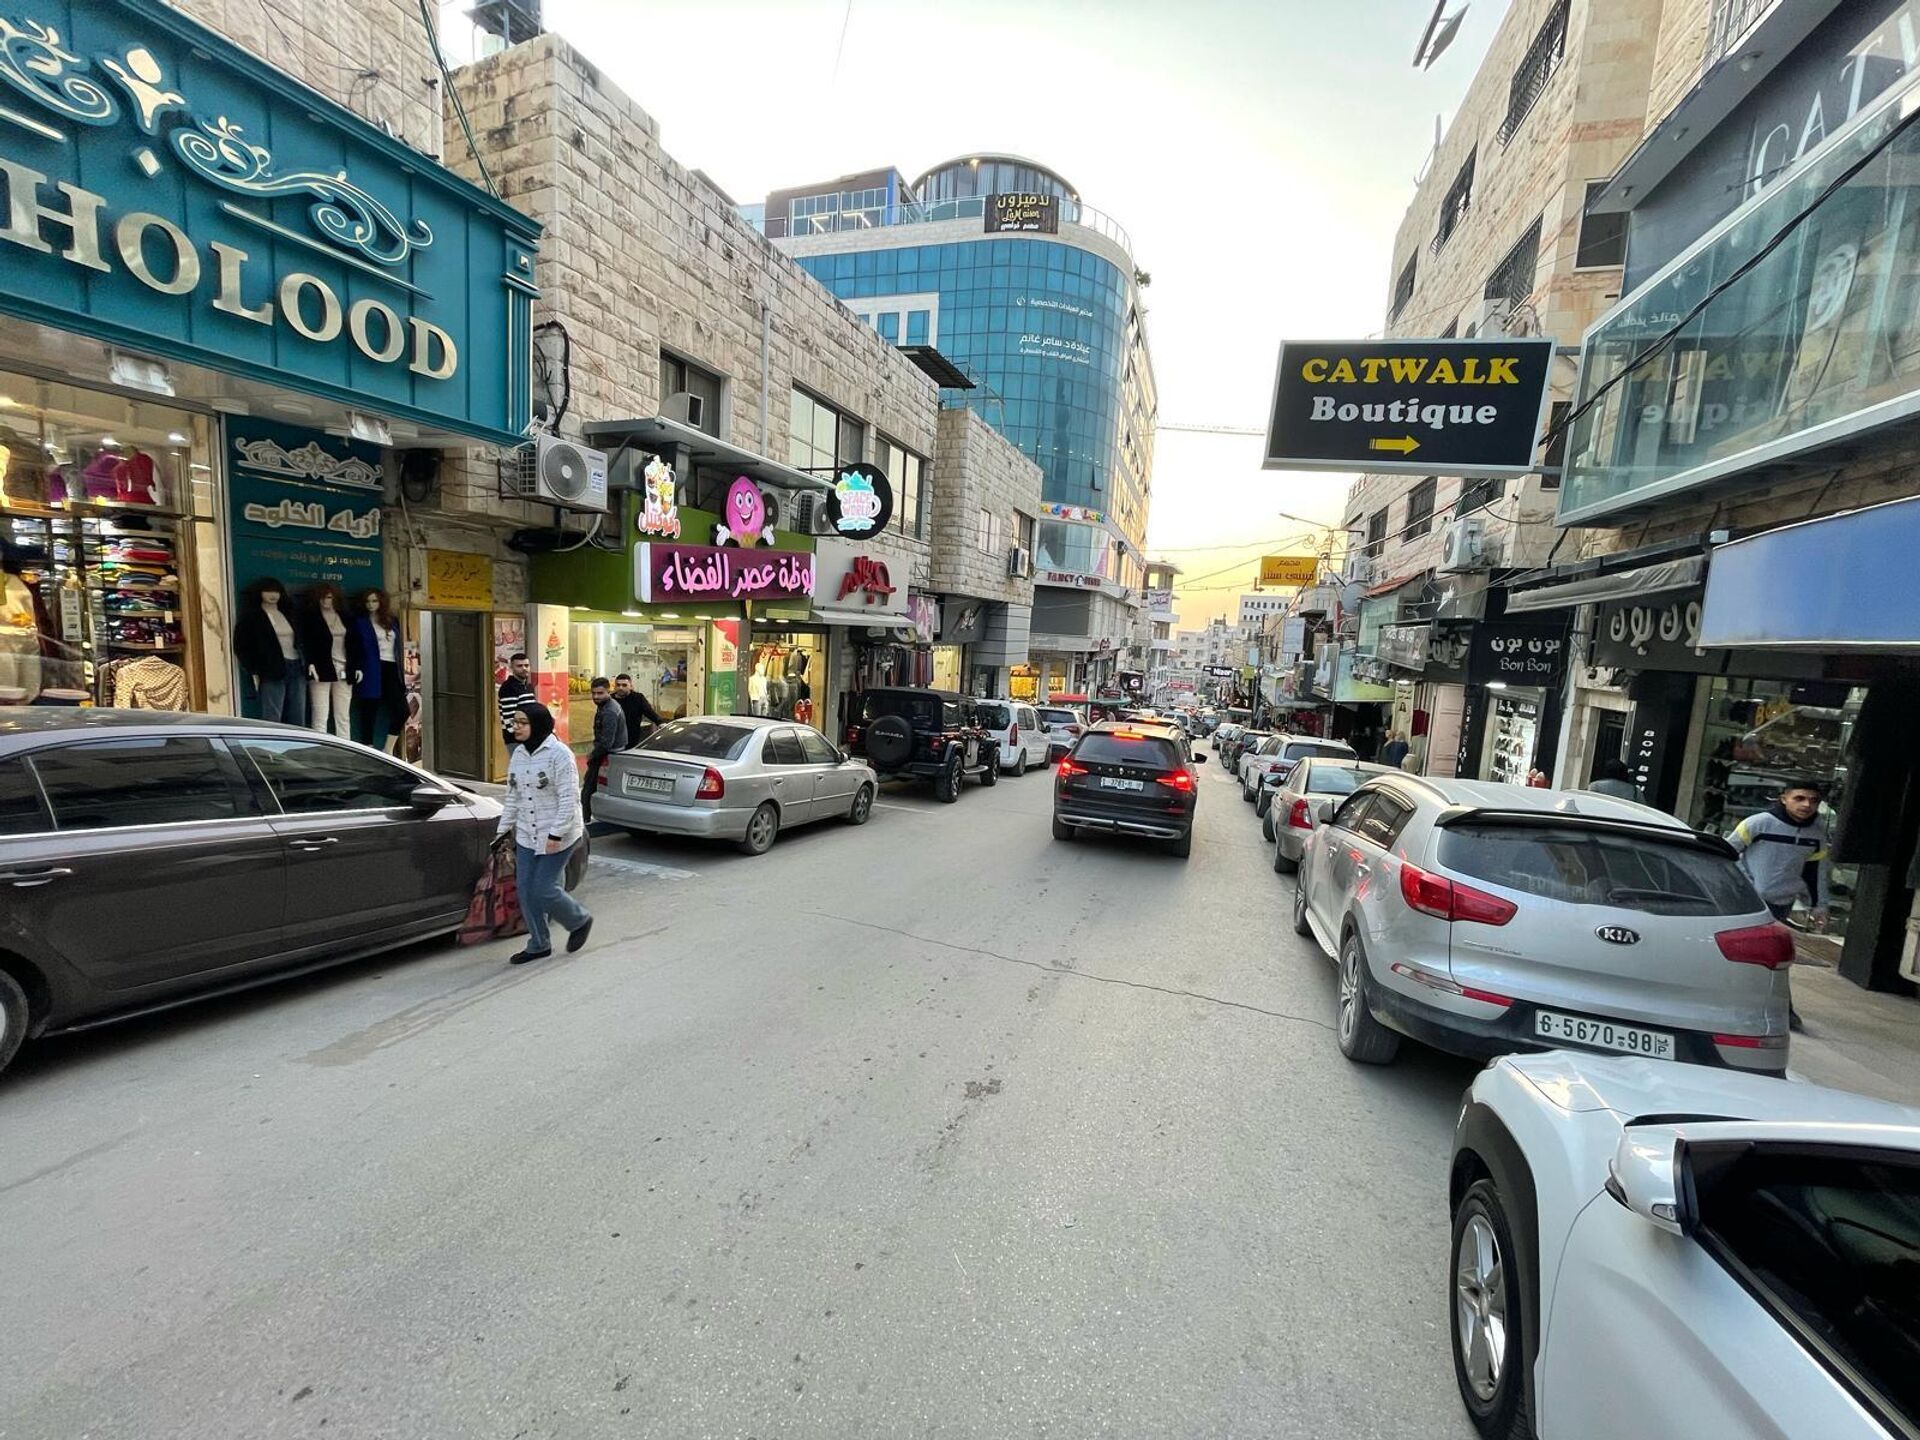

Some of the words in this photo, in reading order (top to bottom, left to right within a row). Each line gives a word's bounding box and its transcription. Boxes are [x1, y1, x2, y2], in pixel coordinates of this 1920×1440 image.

[1018, 333, 1041, 345] غانم
[1040, 336, 1062, 347] سامر
[1302, 358, 1519, 384] CATWALK
[1310, 396, 1498, 430] Boutique
[243, 498, 326, 529] الخلود
[662, 551, 730, 594] الفضاء
[732, 564, 777, 598] عصر
[1658, 602, 1706, 656] ون
[1490, 636, 1523, 653] بون
[1527, 637, 1561, 655] بون
[1500, 657, 1524, 672] Bon
[1527, 658, 1552, 673] Bon
[1129, 678, 1140, 687] G
[1603, 927, 1635, 943] KIA
